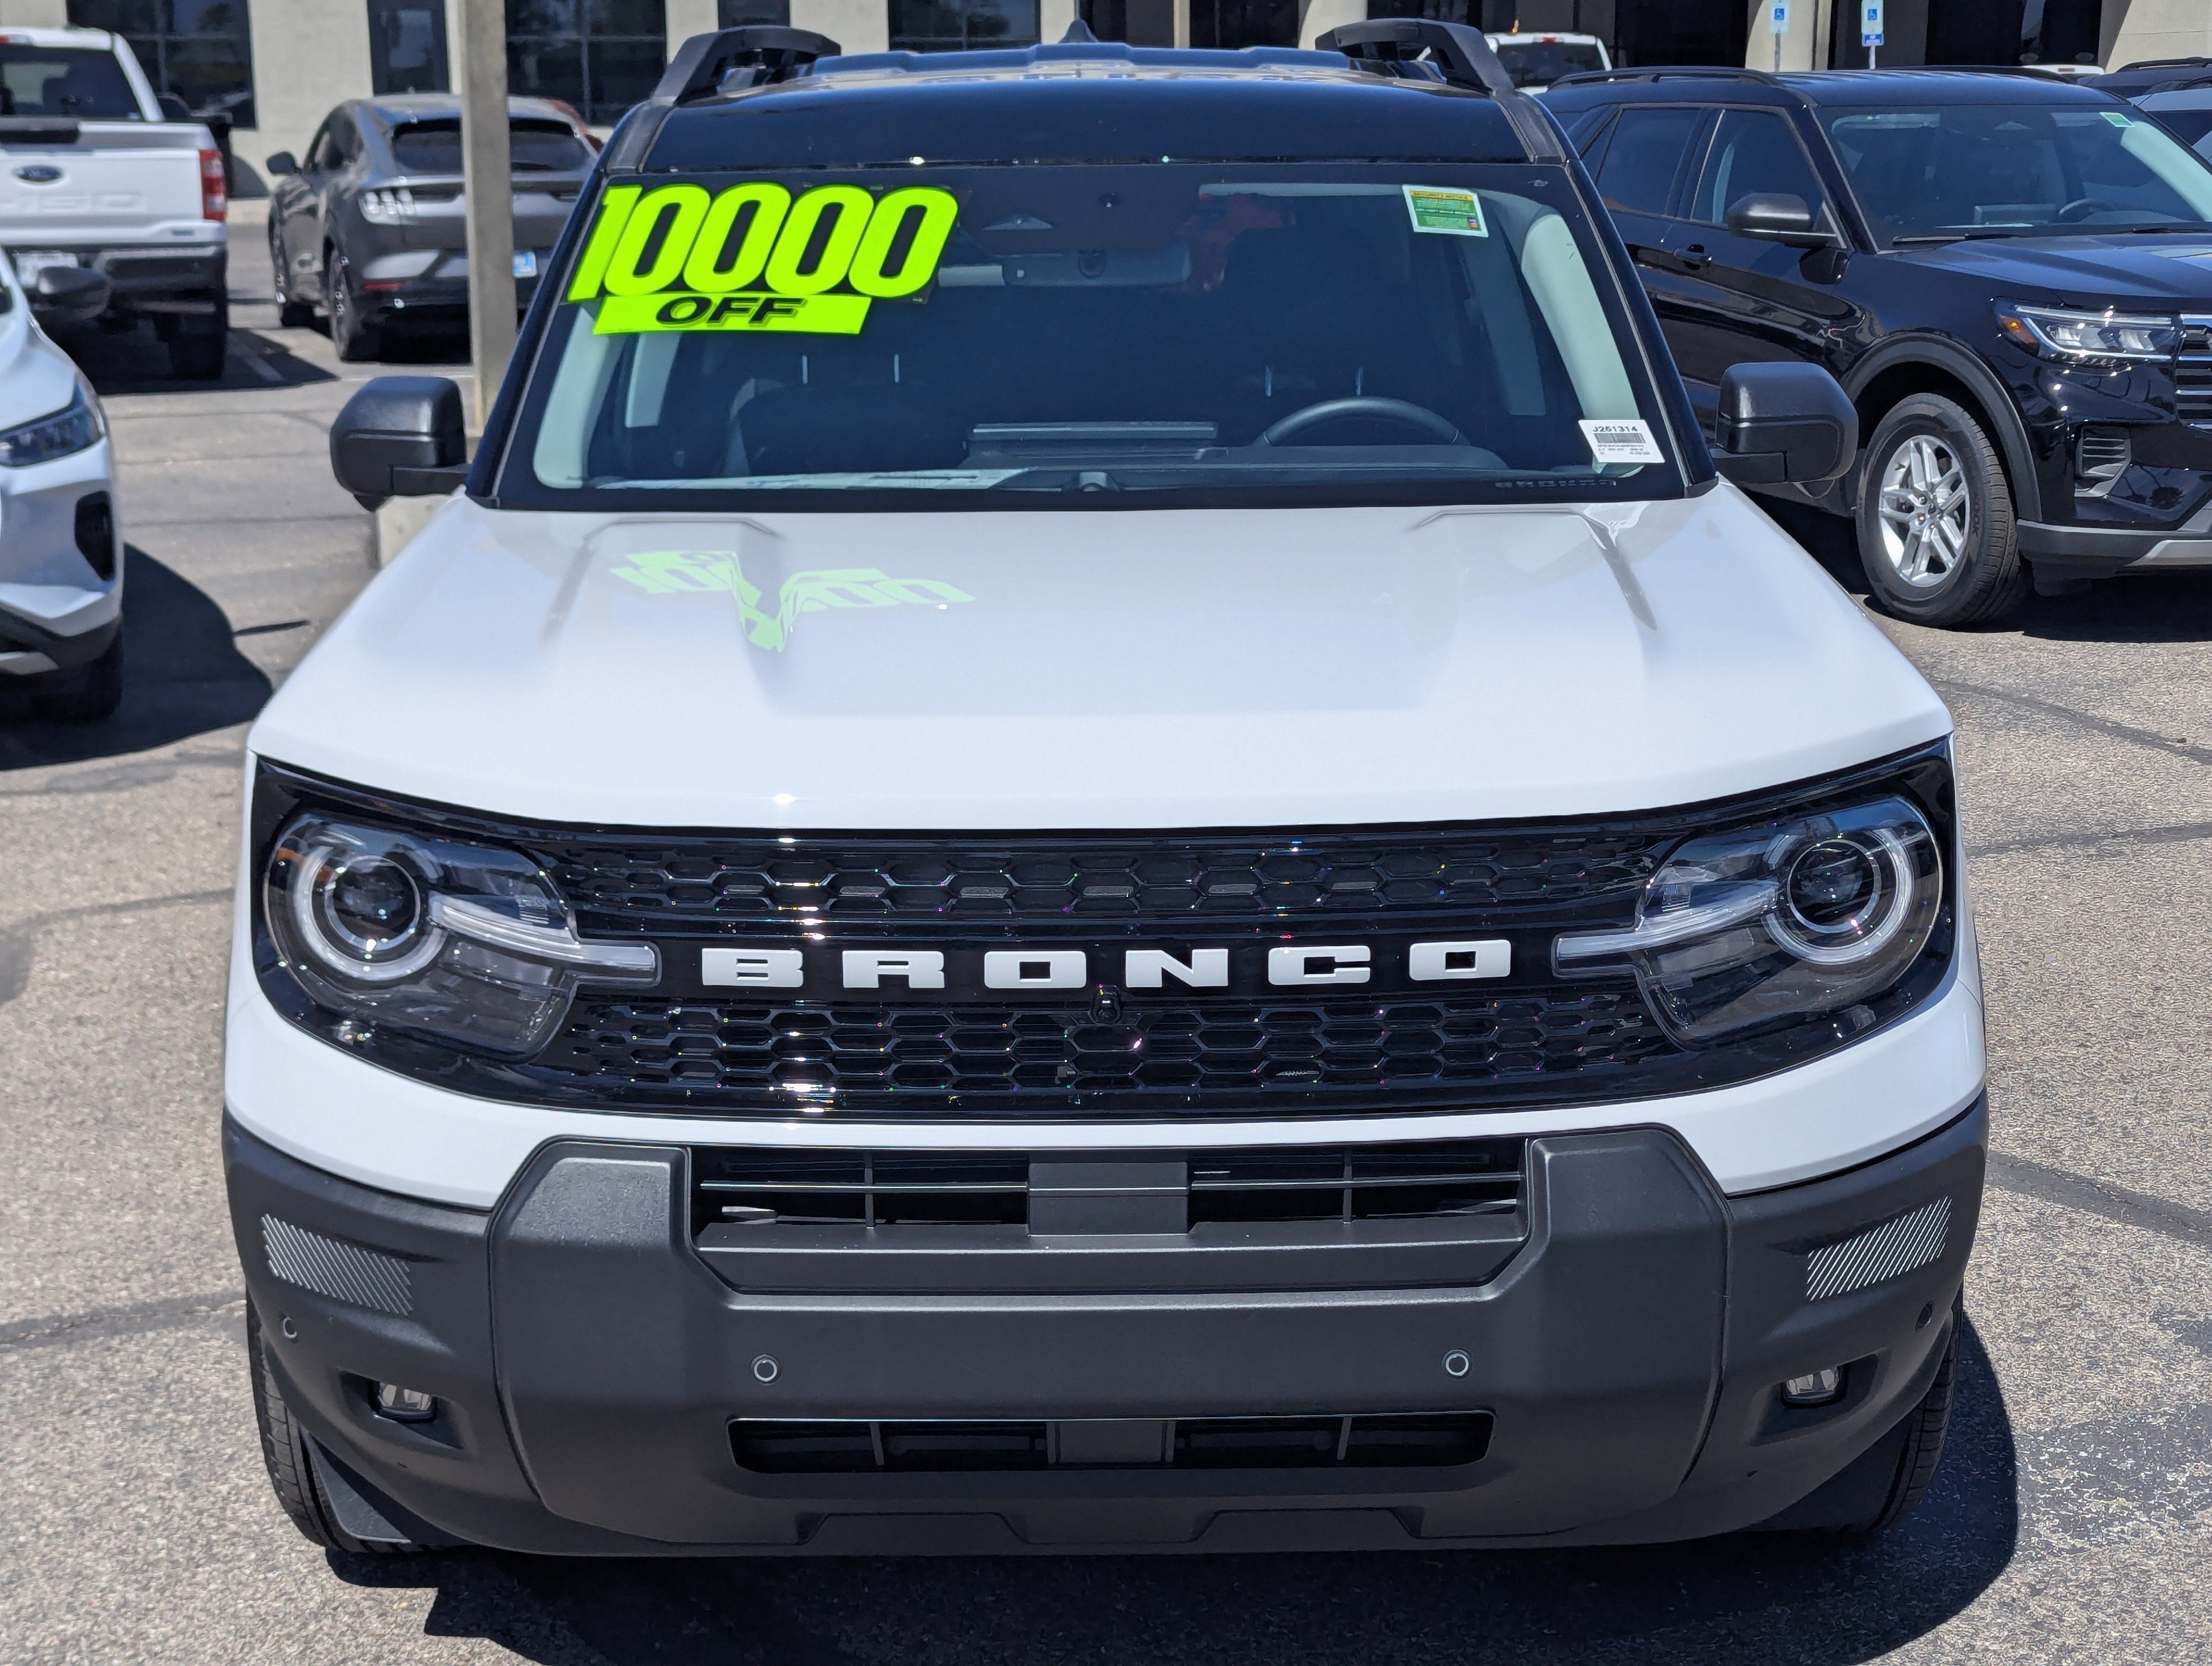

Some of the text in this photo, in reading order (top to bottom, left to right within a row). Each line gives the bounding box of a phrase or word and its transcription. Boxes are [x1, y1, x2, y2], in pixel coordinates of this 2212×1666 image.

[568, 182, 958, 300] 10000
[656, 297, 807, 328] OFF
[702, 939, 1511, 989] BRONCO
